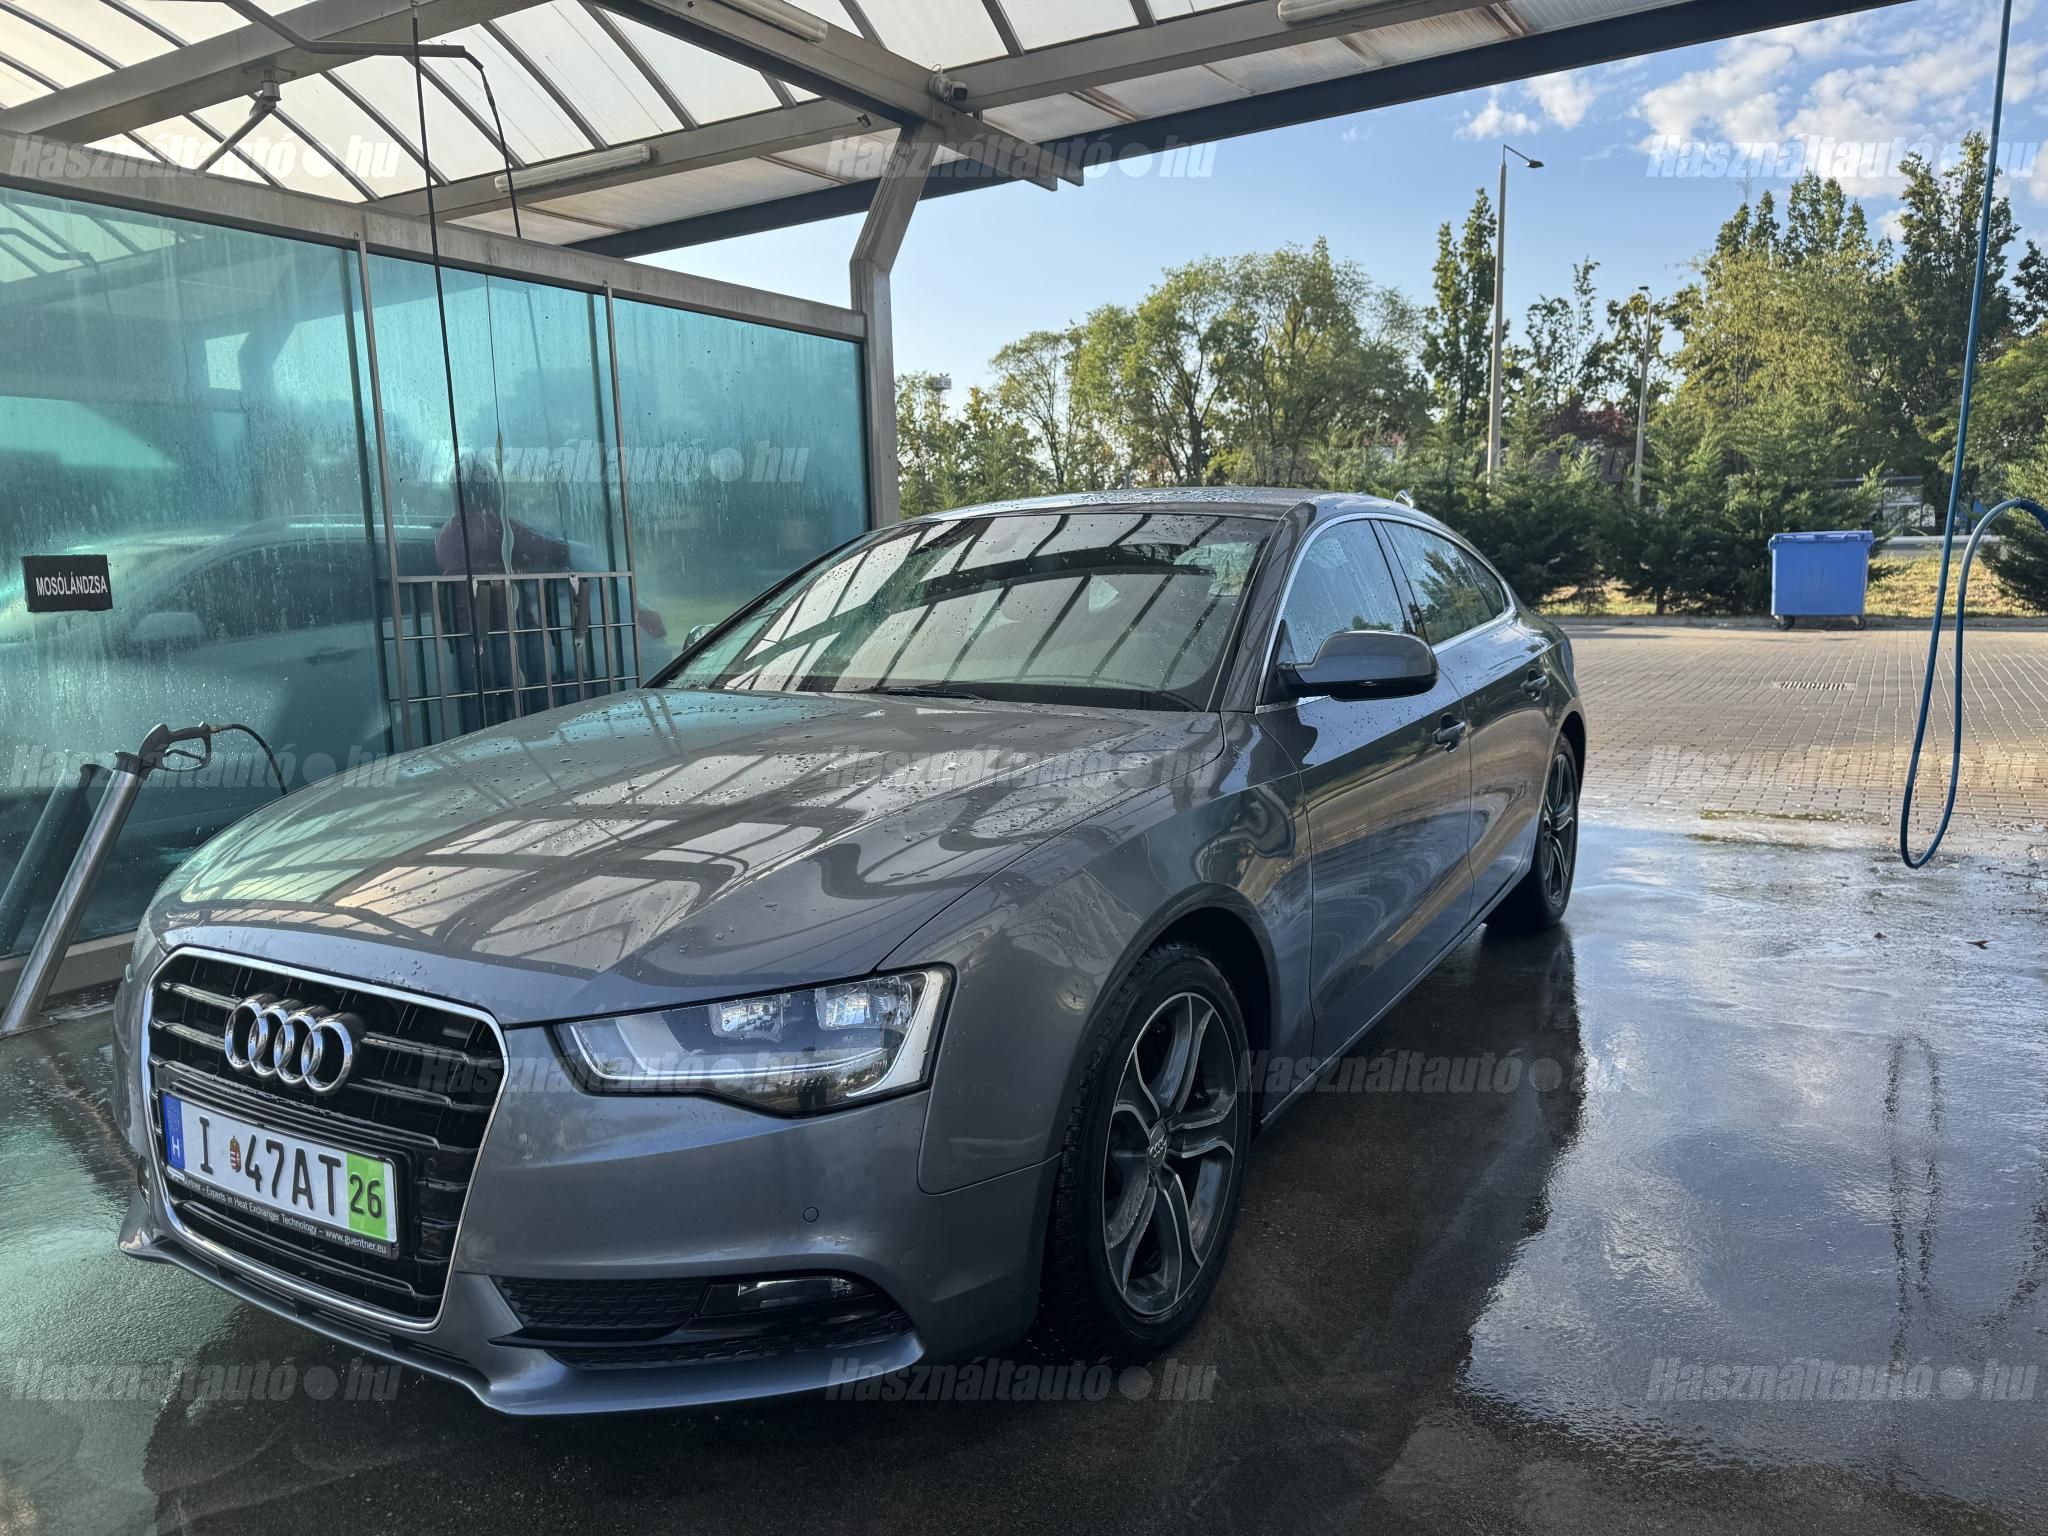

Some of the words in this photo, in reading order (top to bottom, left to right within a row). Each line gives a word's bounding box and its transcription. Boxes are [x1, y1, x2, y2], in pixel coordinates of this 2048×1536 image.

[35, 571, 109, 597] MOSÓLÁNDZSA
[171, 1135, 181, 1158] H
[349, 1173, 383, 1218] 26
[206, 1185, 226, 1202] Experts
[226, 1193, 234, 1204] in
[234, 1196, 249, 1210] Heat
[249, 1202, 280, 1222] Exchanger
[280, 1213, 318, 1236] Technology
[324, 1229, 387, 1254] www.guentner.eu
